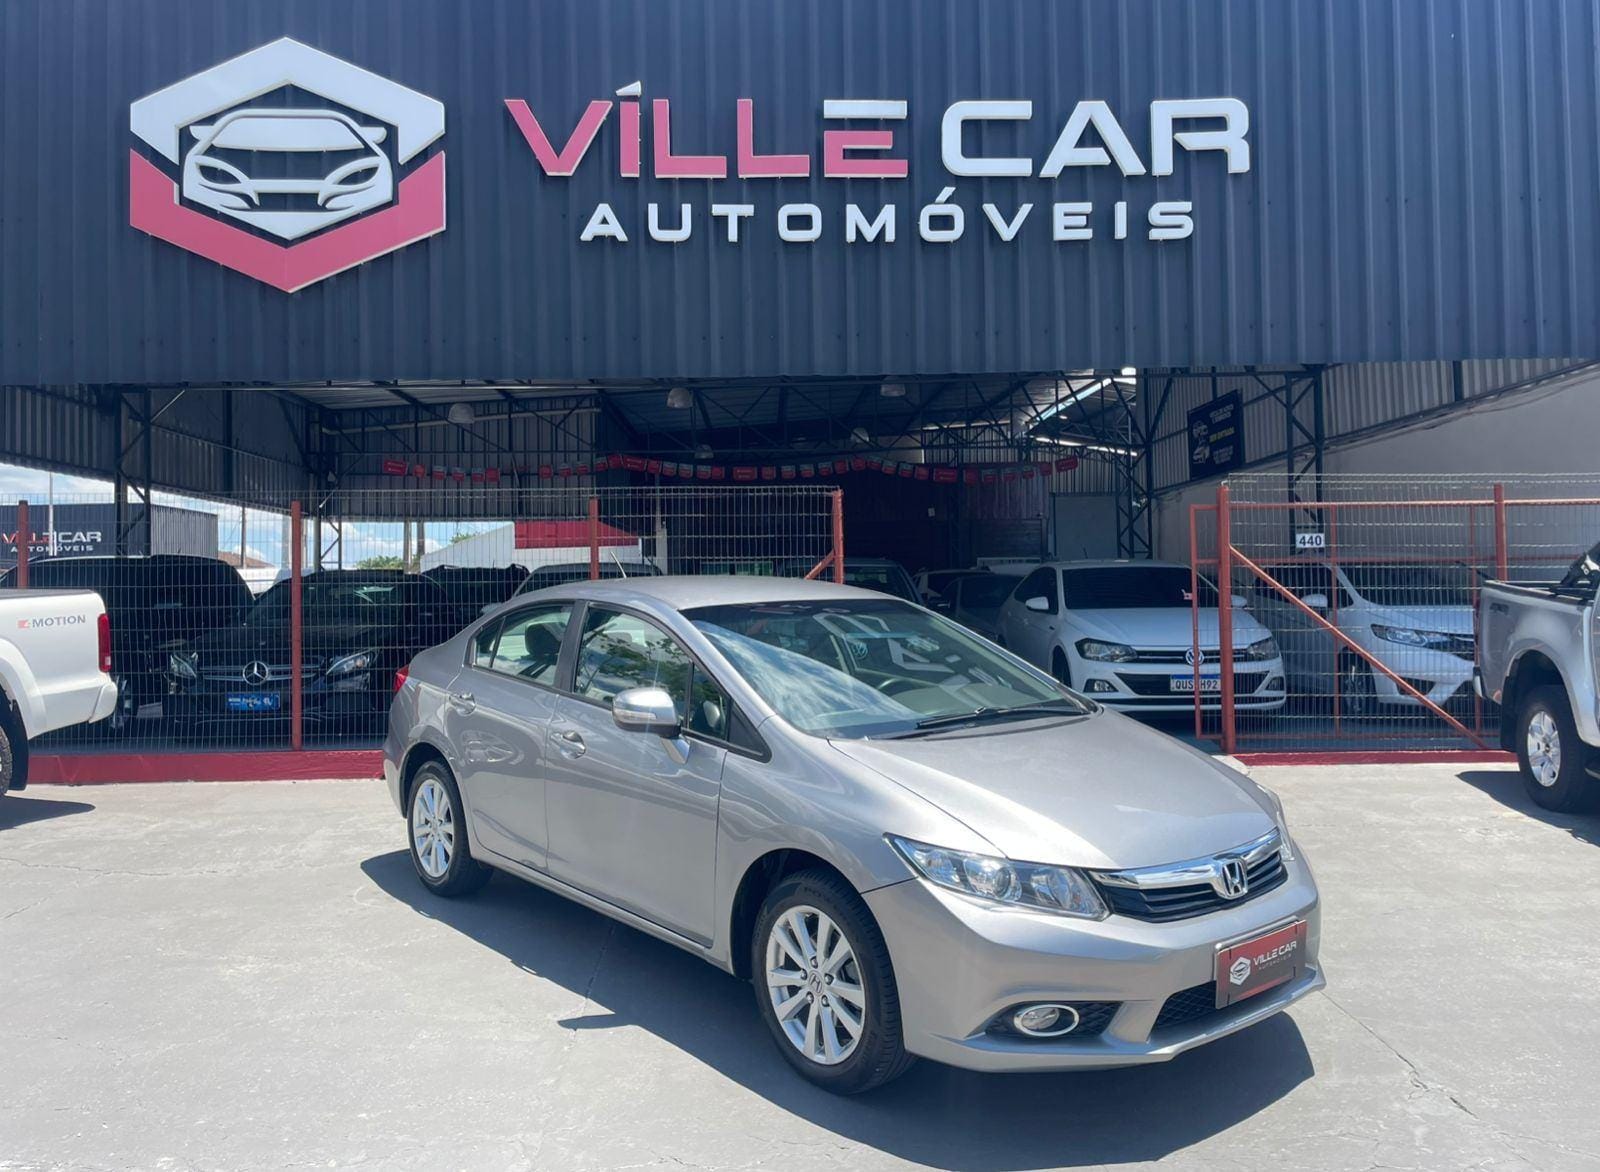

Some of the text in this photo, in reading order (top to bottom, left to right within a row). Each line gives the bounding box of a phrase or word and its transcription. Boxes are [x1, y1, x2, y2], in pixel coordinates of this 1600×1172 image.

[504, 80, 1250, 179] VÍLLE CAR
[580, 186, 1195, 243] AUTOMÓVEIS
[58, 531, 102, 543] CAR
[1298, 535, 1322, 547] 440
[10, 543, 94, 553] ATOÓVEIS
[1278, 940, 1297, 956] CAR
